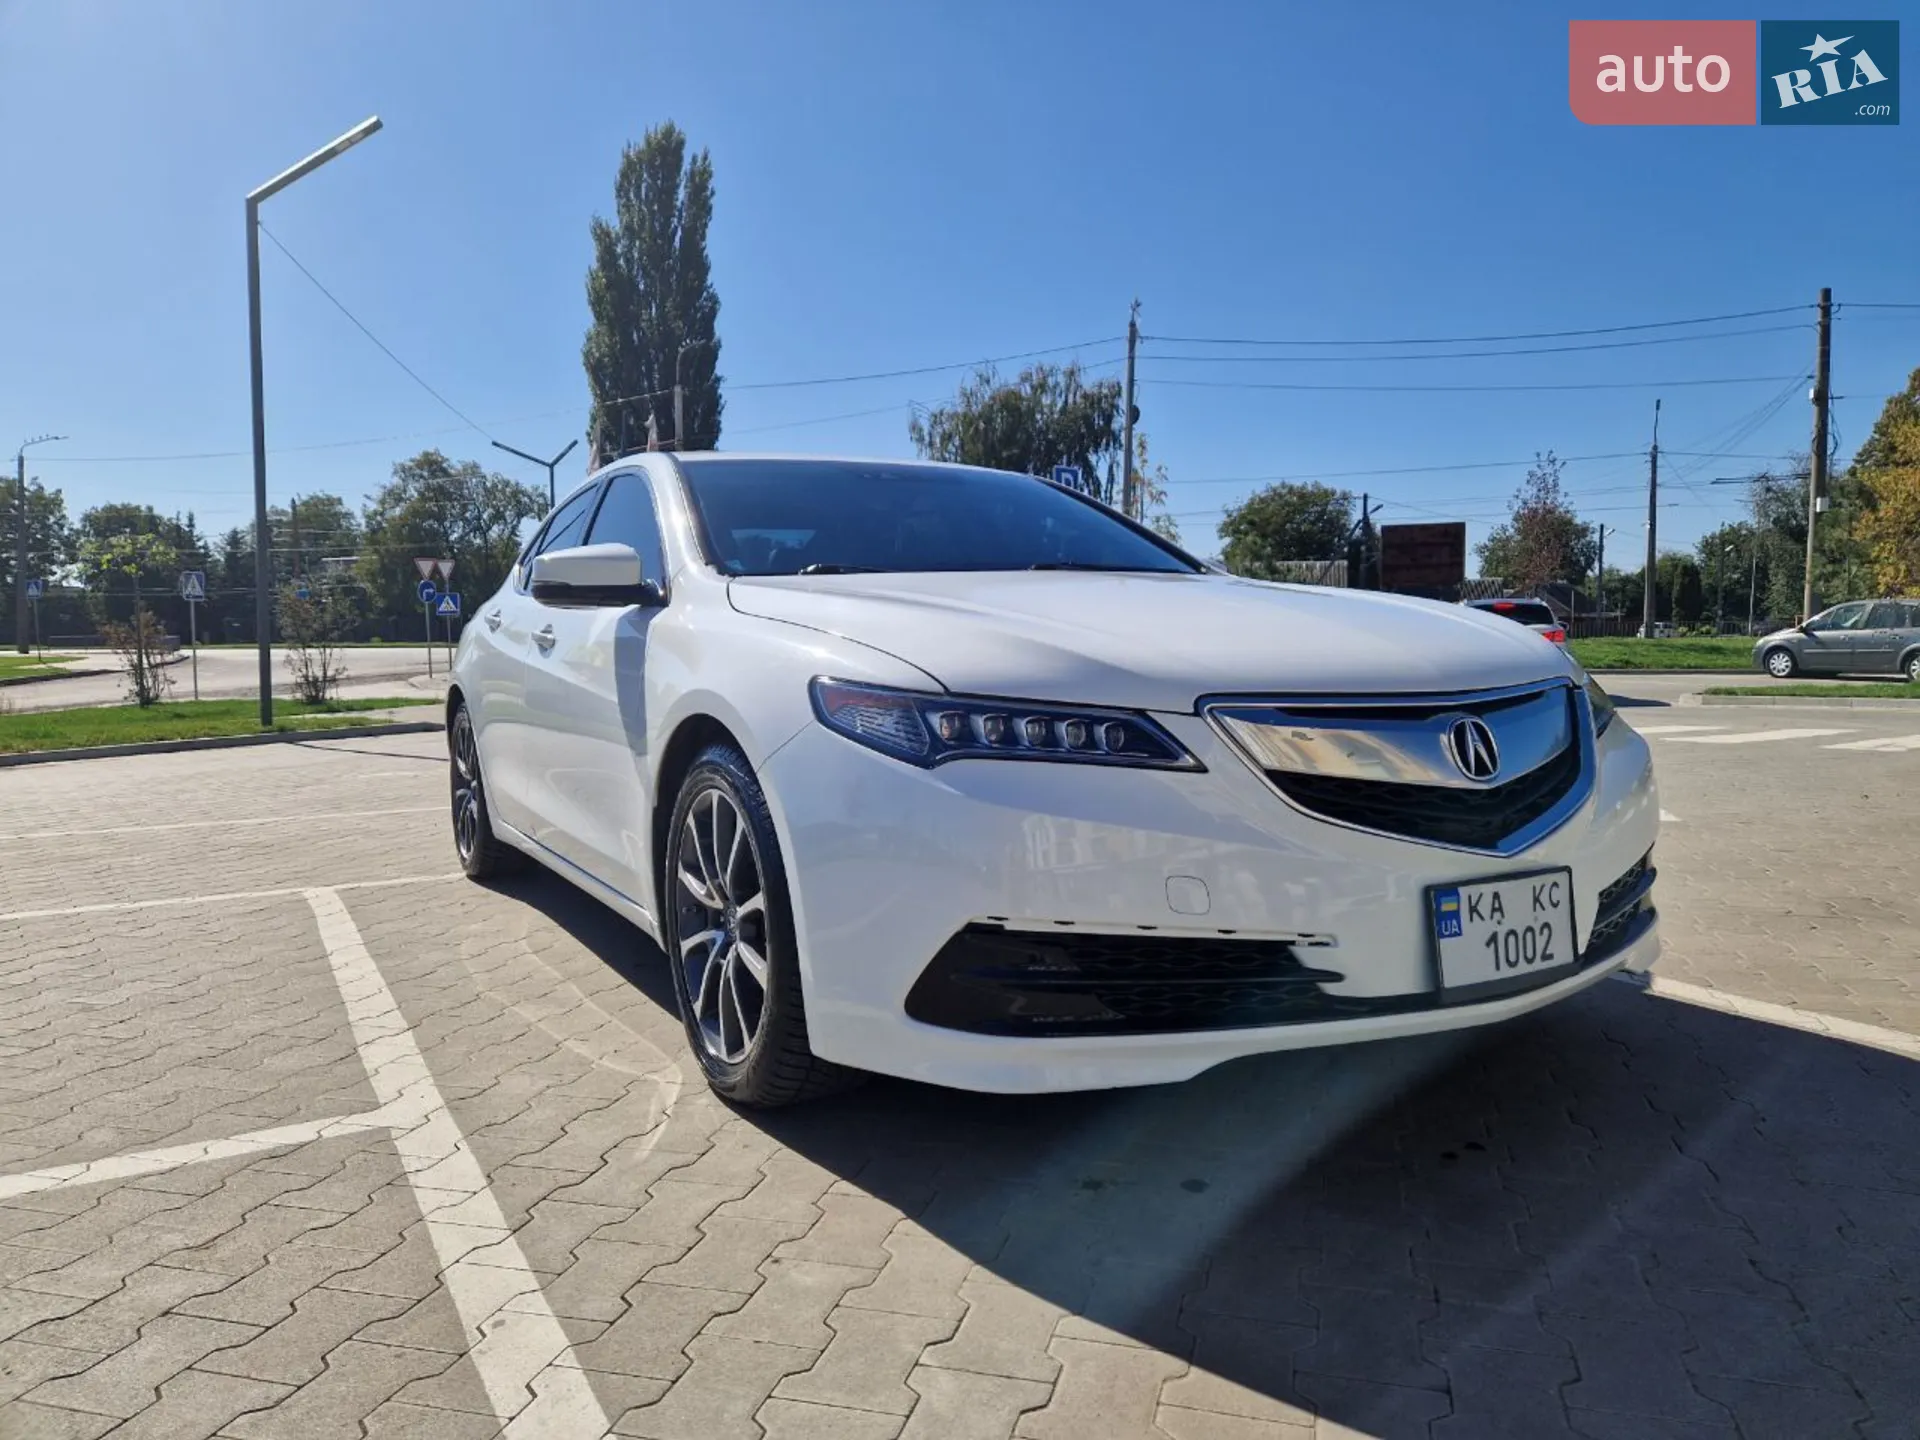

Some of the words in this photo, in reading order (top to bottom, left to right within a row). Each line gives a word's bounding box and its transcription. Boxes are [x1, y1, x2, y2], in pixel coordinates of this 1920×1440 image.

[1468, 890, 1506, 923] KA
[1532, 881, 1561, 913] KC
[1441, 918, 1461, 936] UA
[1485, 921, 1554, 972] 1002
